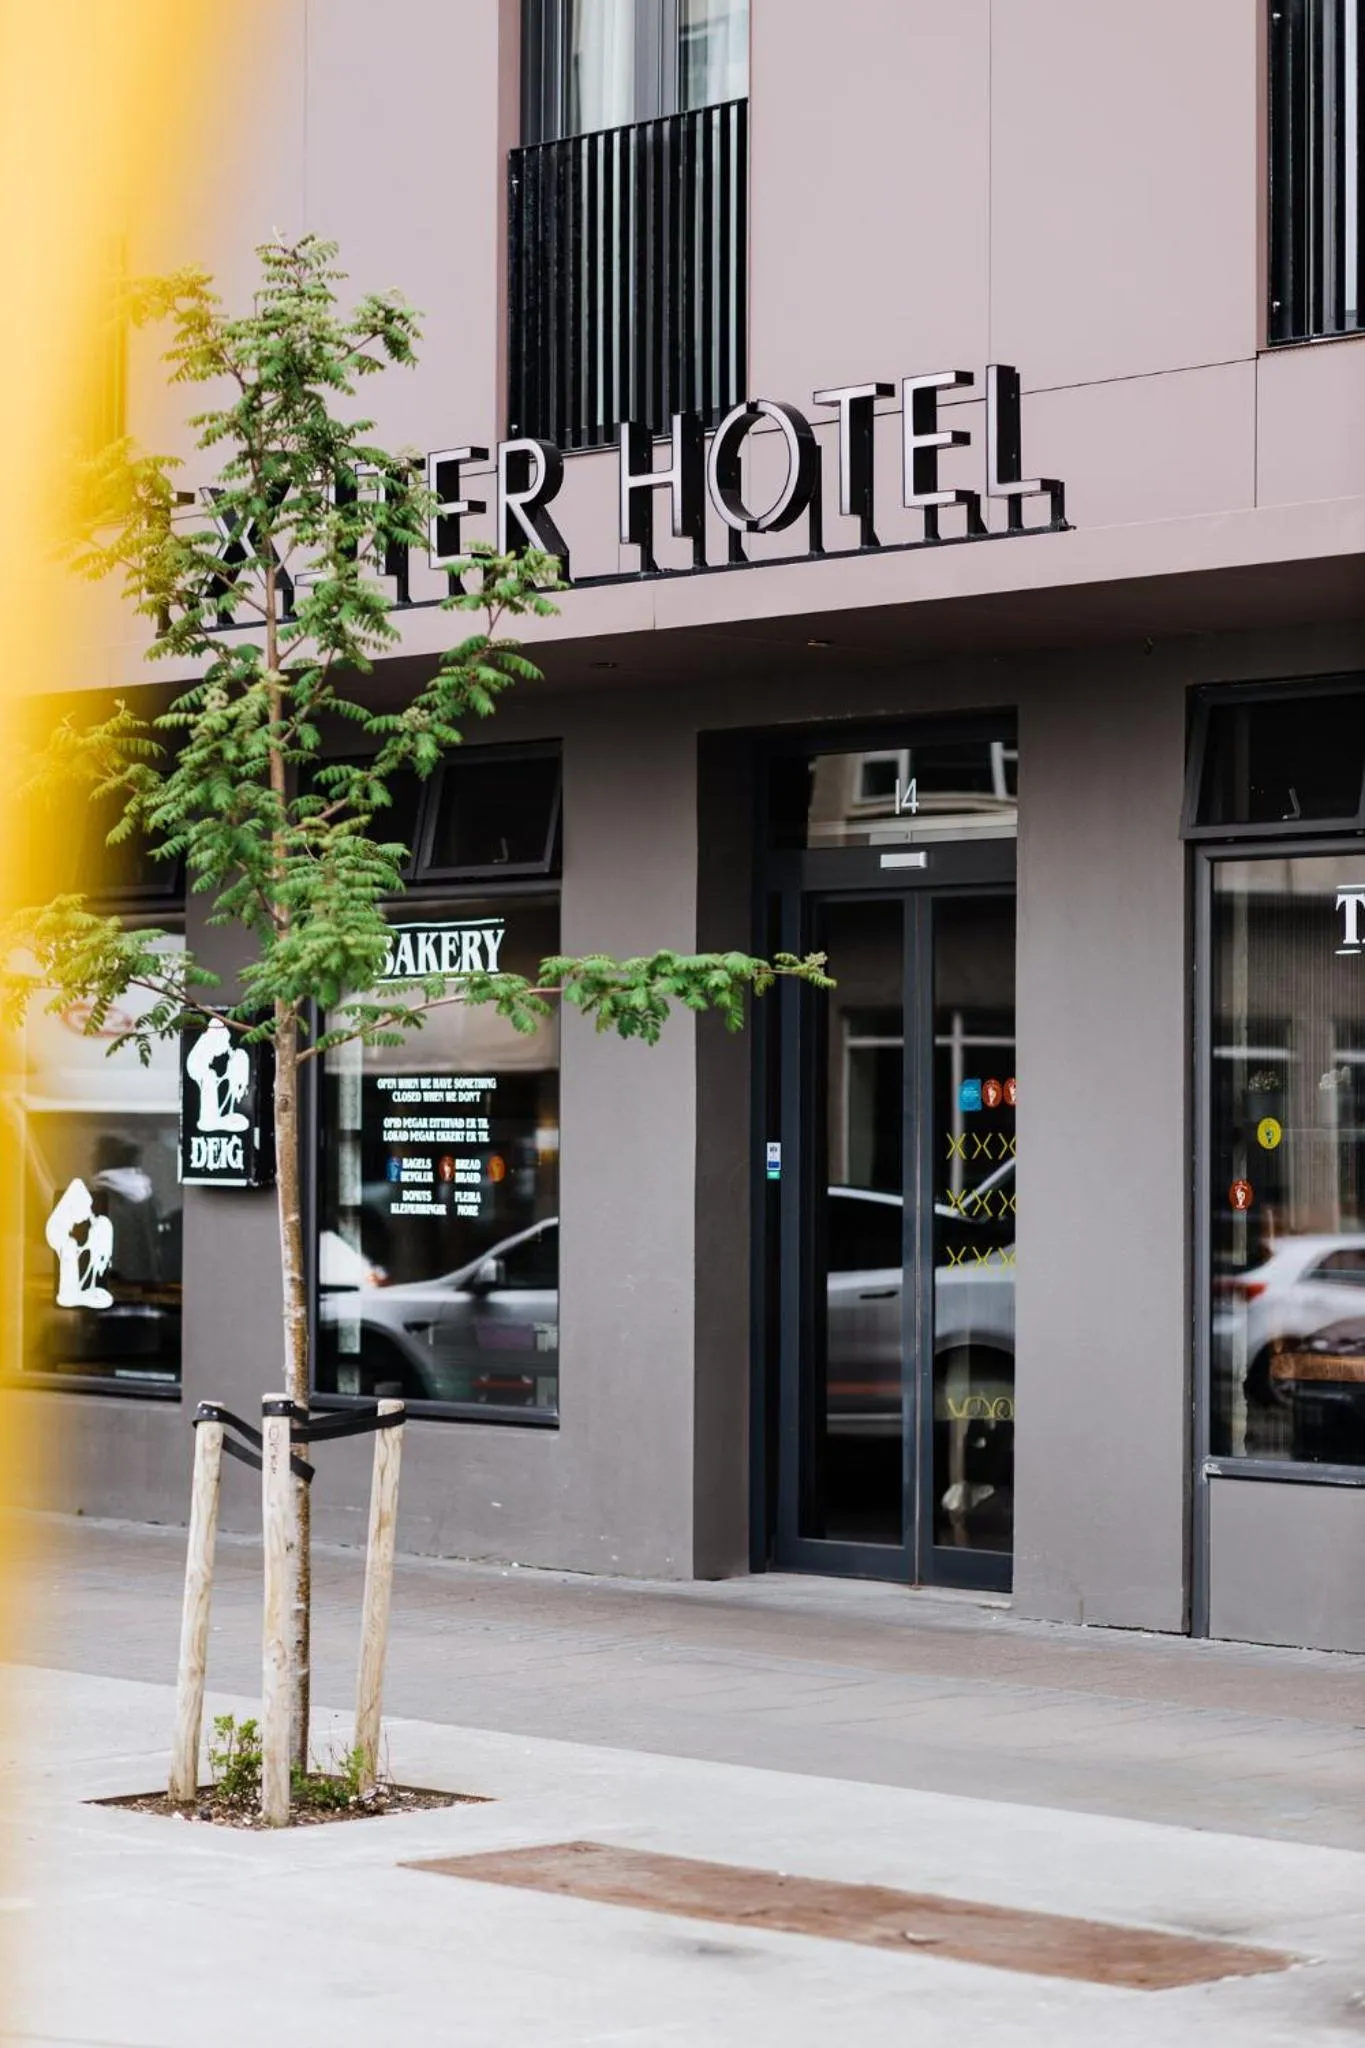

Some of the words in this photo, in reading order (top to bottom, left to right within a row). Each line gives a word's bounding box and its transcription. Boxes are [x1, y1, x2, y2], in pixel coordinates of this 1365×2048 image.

[620, 364, 1064, 544] HOTEL
[895, 778, 919, 814] 14
[392, 1091, 421, 1102] CLOSED
[190, 1135, 244, 1171] DEIG
[402, 1158, 432, 1169] BAGELS
